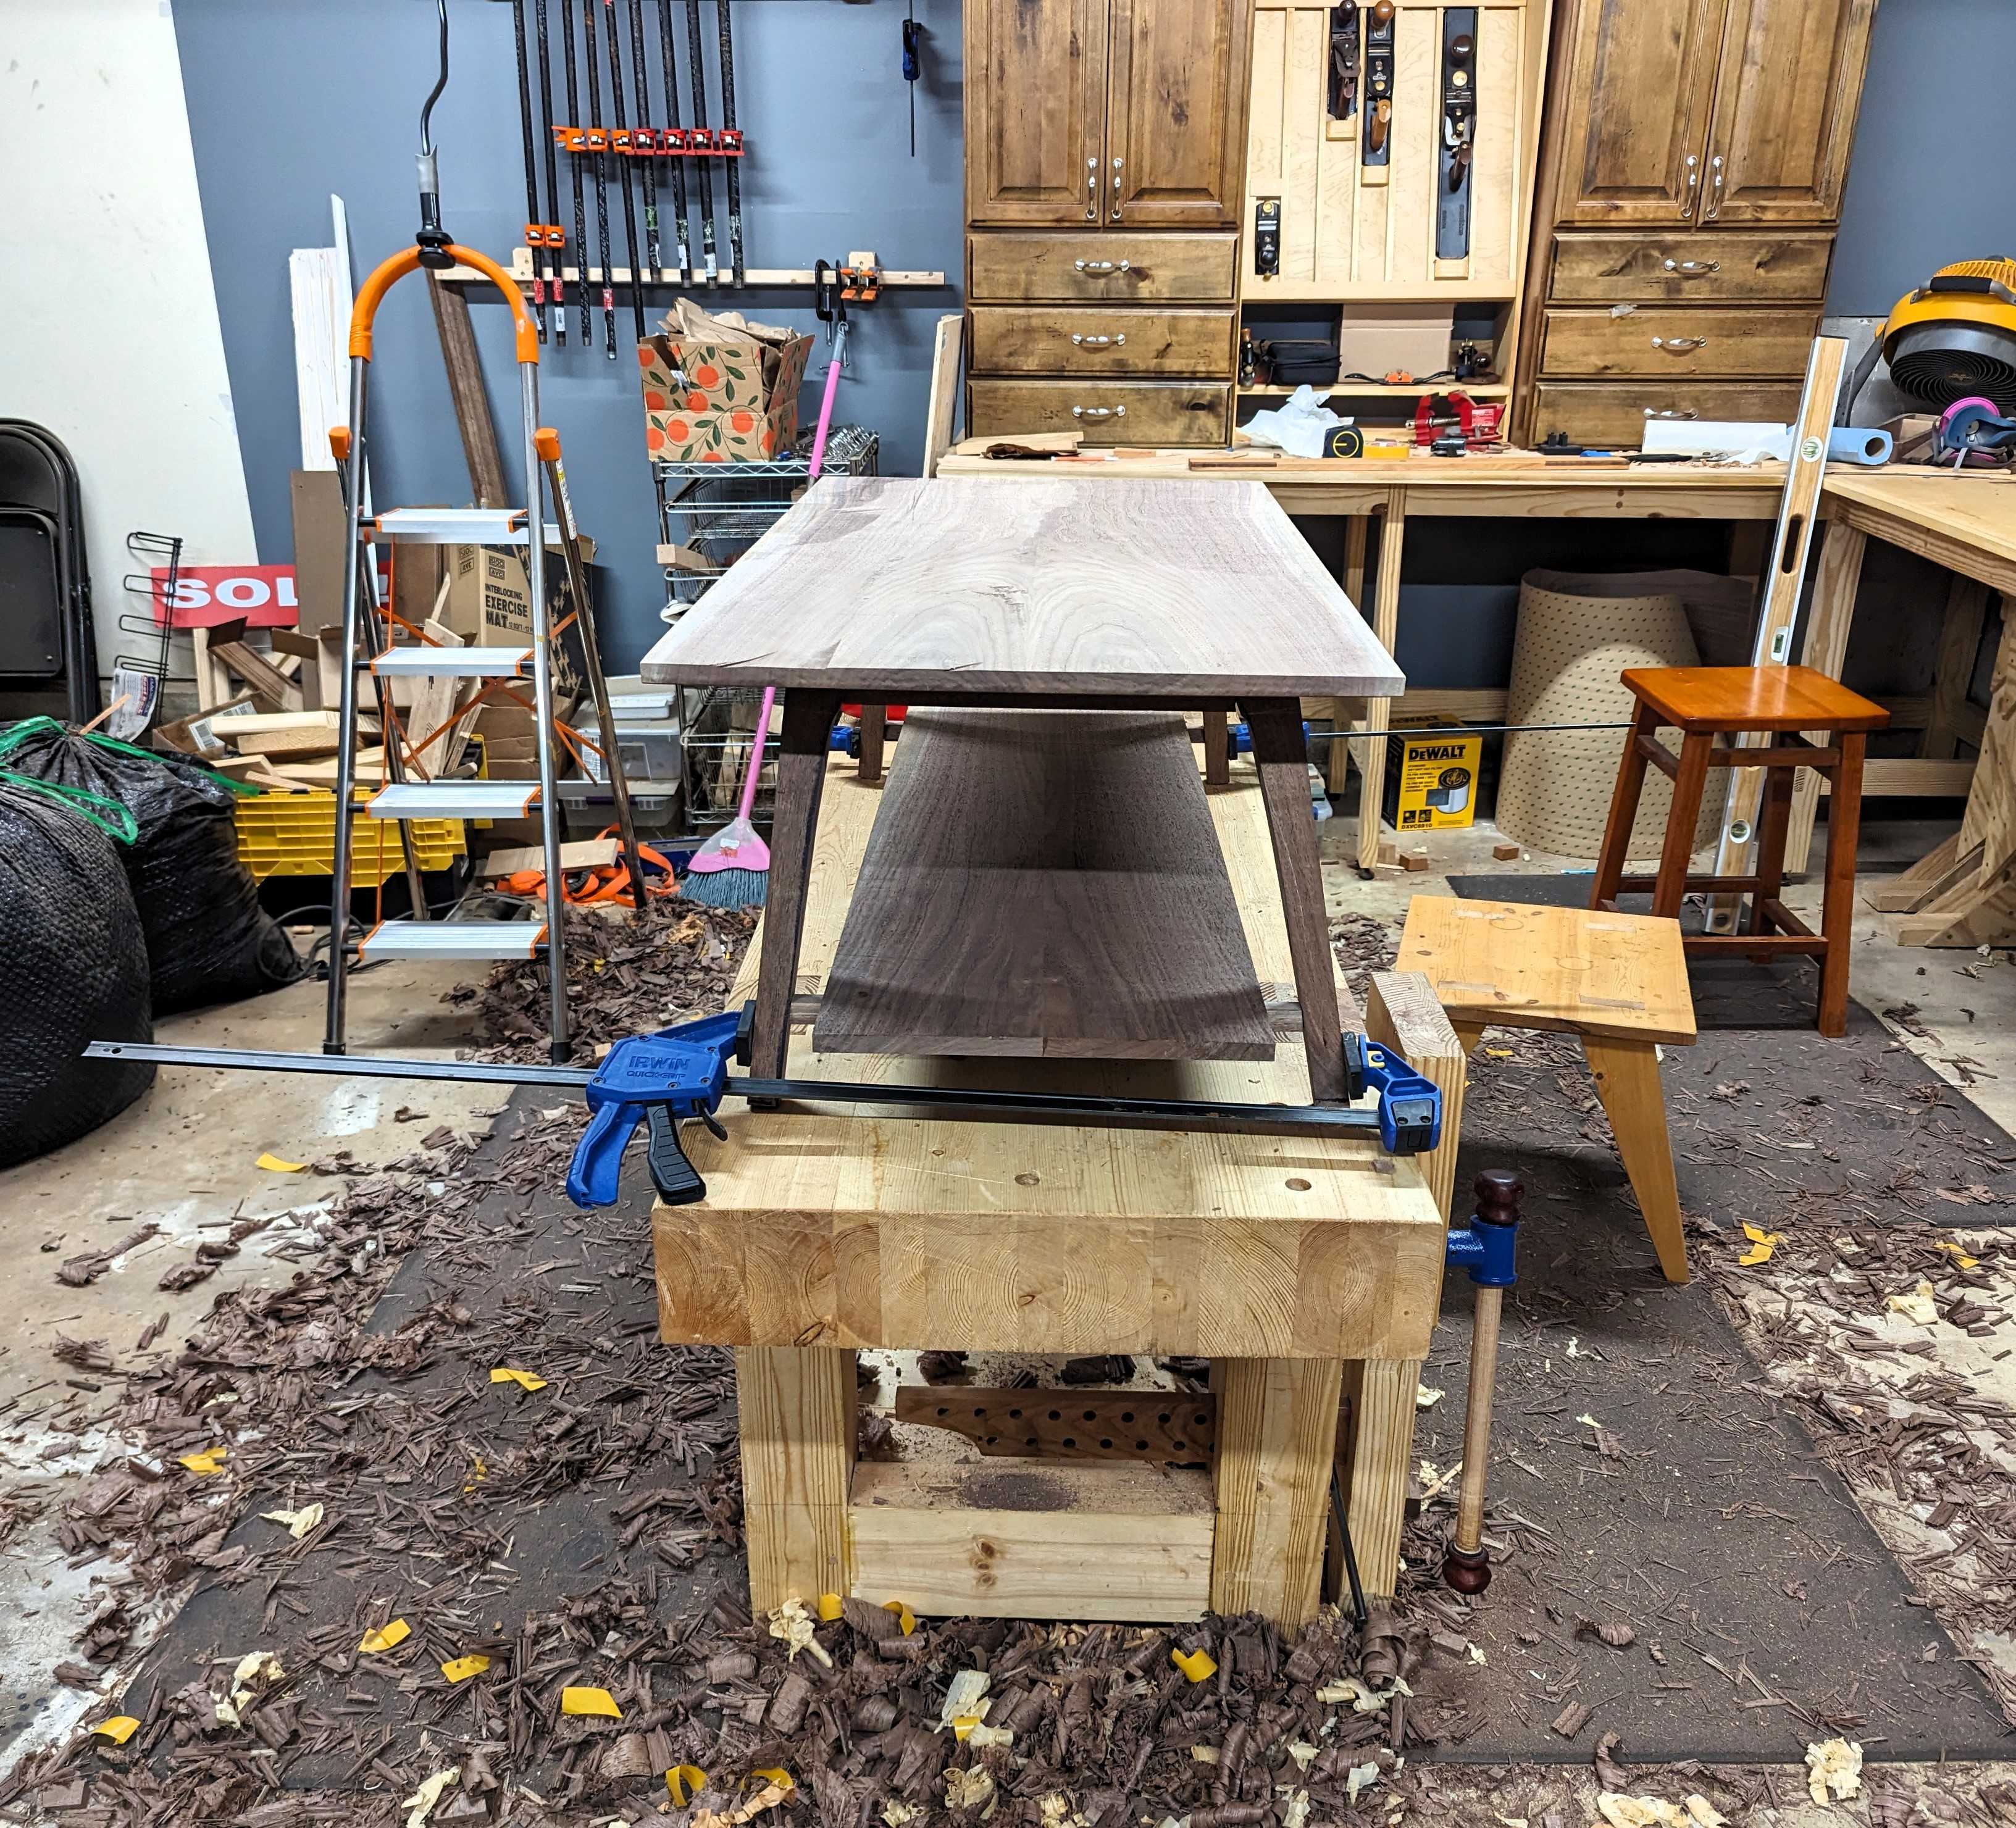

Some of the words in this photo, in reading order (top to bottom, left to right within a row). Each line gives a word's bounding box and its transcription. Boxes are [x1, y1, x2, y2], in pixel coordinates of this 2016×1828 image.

[162, 577, 298, 608] SOL
[485, 583, 522, 601] INTERLOCKING
[485, 595, 528, 618] EXERCISE
[486, 610, 509, 628] MAT
[629, 1056, 691, 1070] IRWIN
